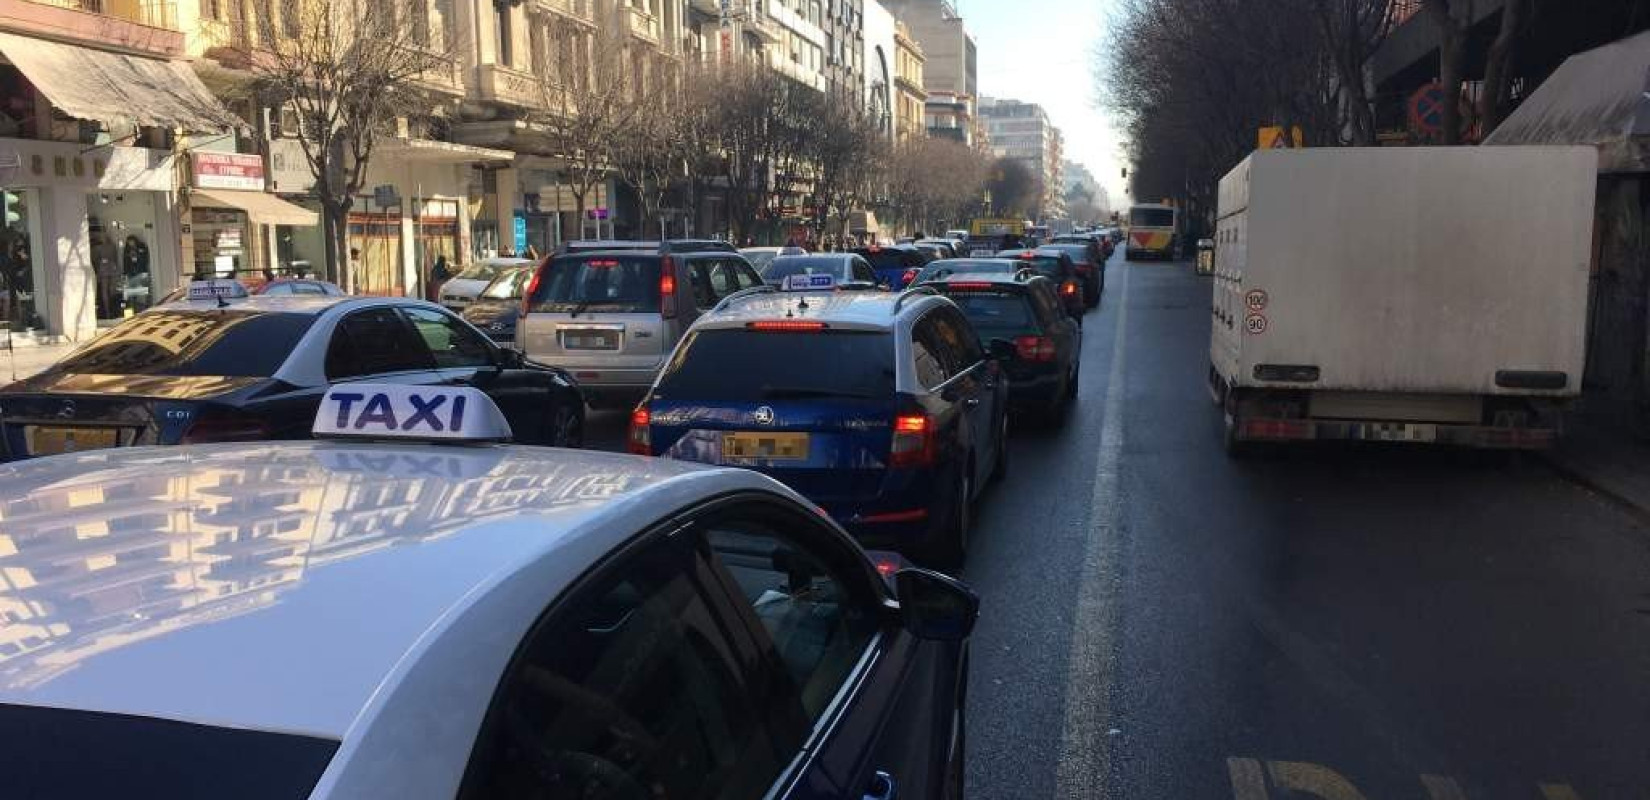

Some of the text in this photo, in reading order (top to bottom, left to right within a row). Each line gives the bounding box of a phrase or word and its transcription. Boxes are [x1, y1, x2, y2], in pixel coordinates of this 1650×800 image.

[1248, 295, 1264, 305] 100
[1249, 319, 1263, 330] 90
[330, 393, 466, 431] TAXI
